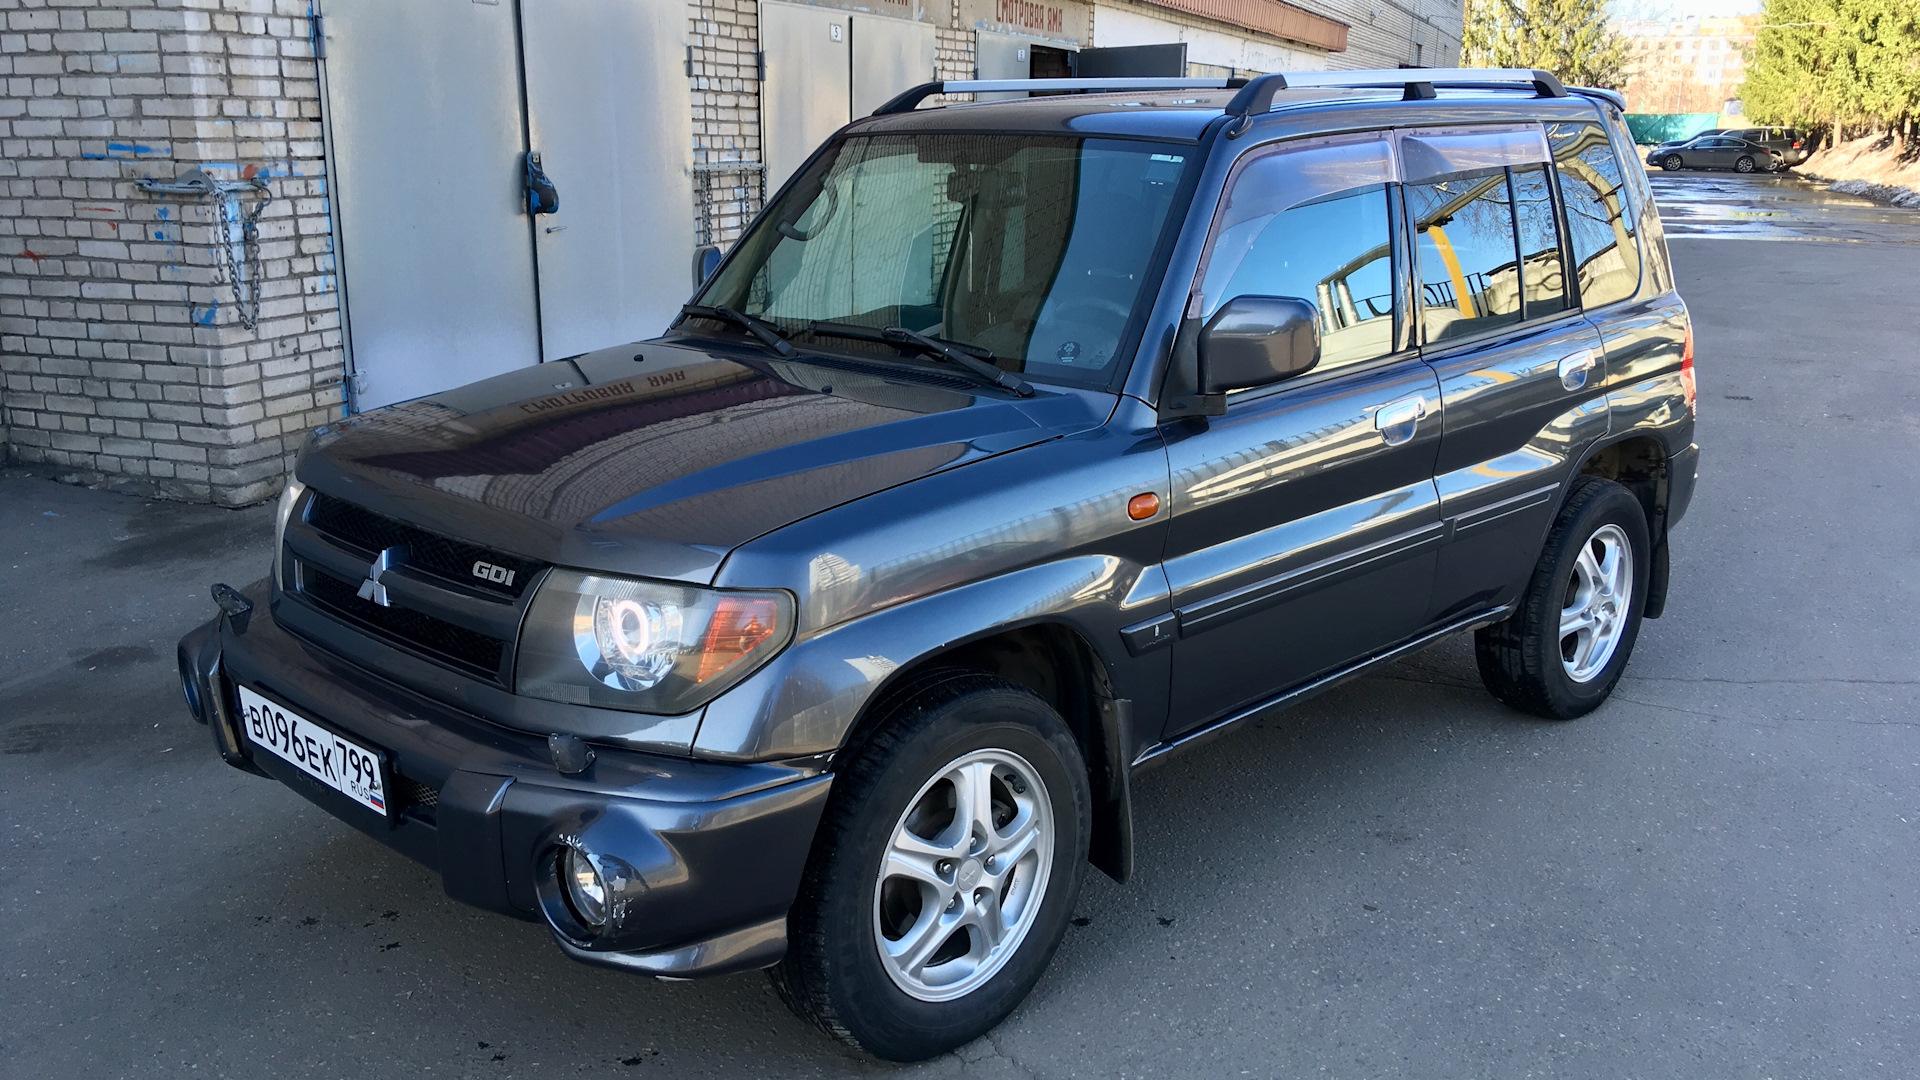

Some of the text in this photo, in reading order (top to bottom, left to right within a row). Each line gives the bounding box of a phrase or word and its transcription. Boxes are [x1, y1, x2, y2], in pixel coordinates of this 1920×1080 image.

[996, 0, 1063, 33] СМОТРОВАЯ ЯМА
[472, 560, 515, 587] GDI
[335, 740, 376, 790] 799
[350, 779, 370, 801] RUS
